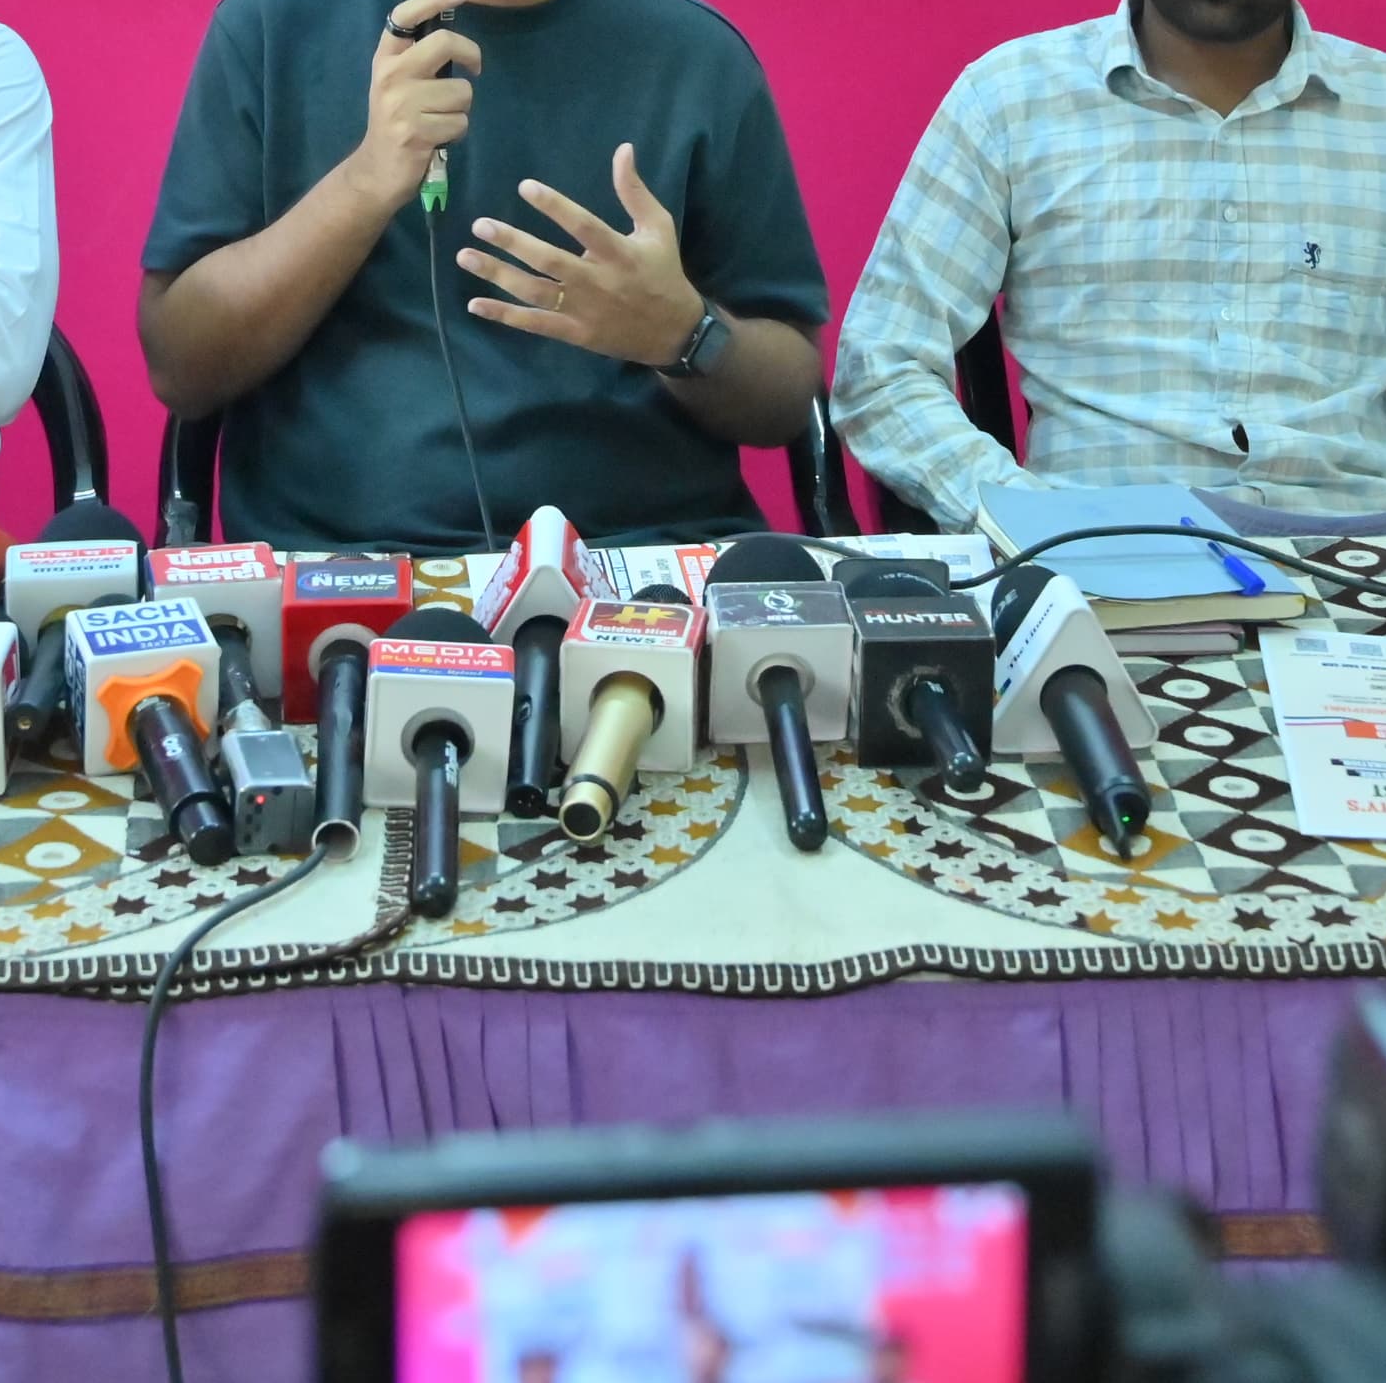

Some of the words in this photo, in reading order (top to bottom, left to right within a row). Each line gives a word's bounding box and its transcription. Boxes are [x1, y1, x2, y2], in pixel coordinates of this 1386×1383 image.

[165, 550, 256, 566] पंजाब
[165, 562, 265, 582] केसरी
[311, 575, 397, 586] NEWS
[86, 603, 187, 626] SACH
[864, 613, 973, 624] HUNTER
[94, 622, 197, 648] INDIA
[596, 635, 656, 644] NEWS
[381, 643, 502, 658] MEDIA
[381, 655, 433, 664] PLUS
[443, 658, 502, 666] NEWS
